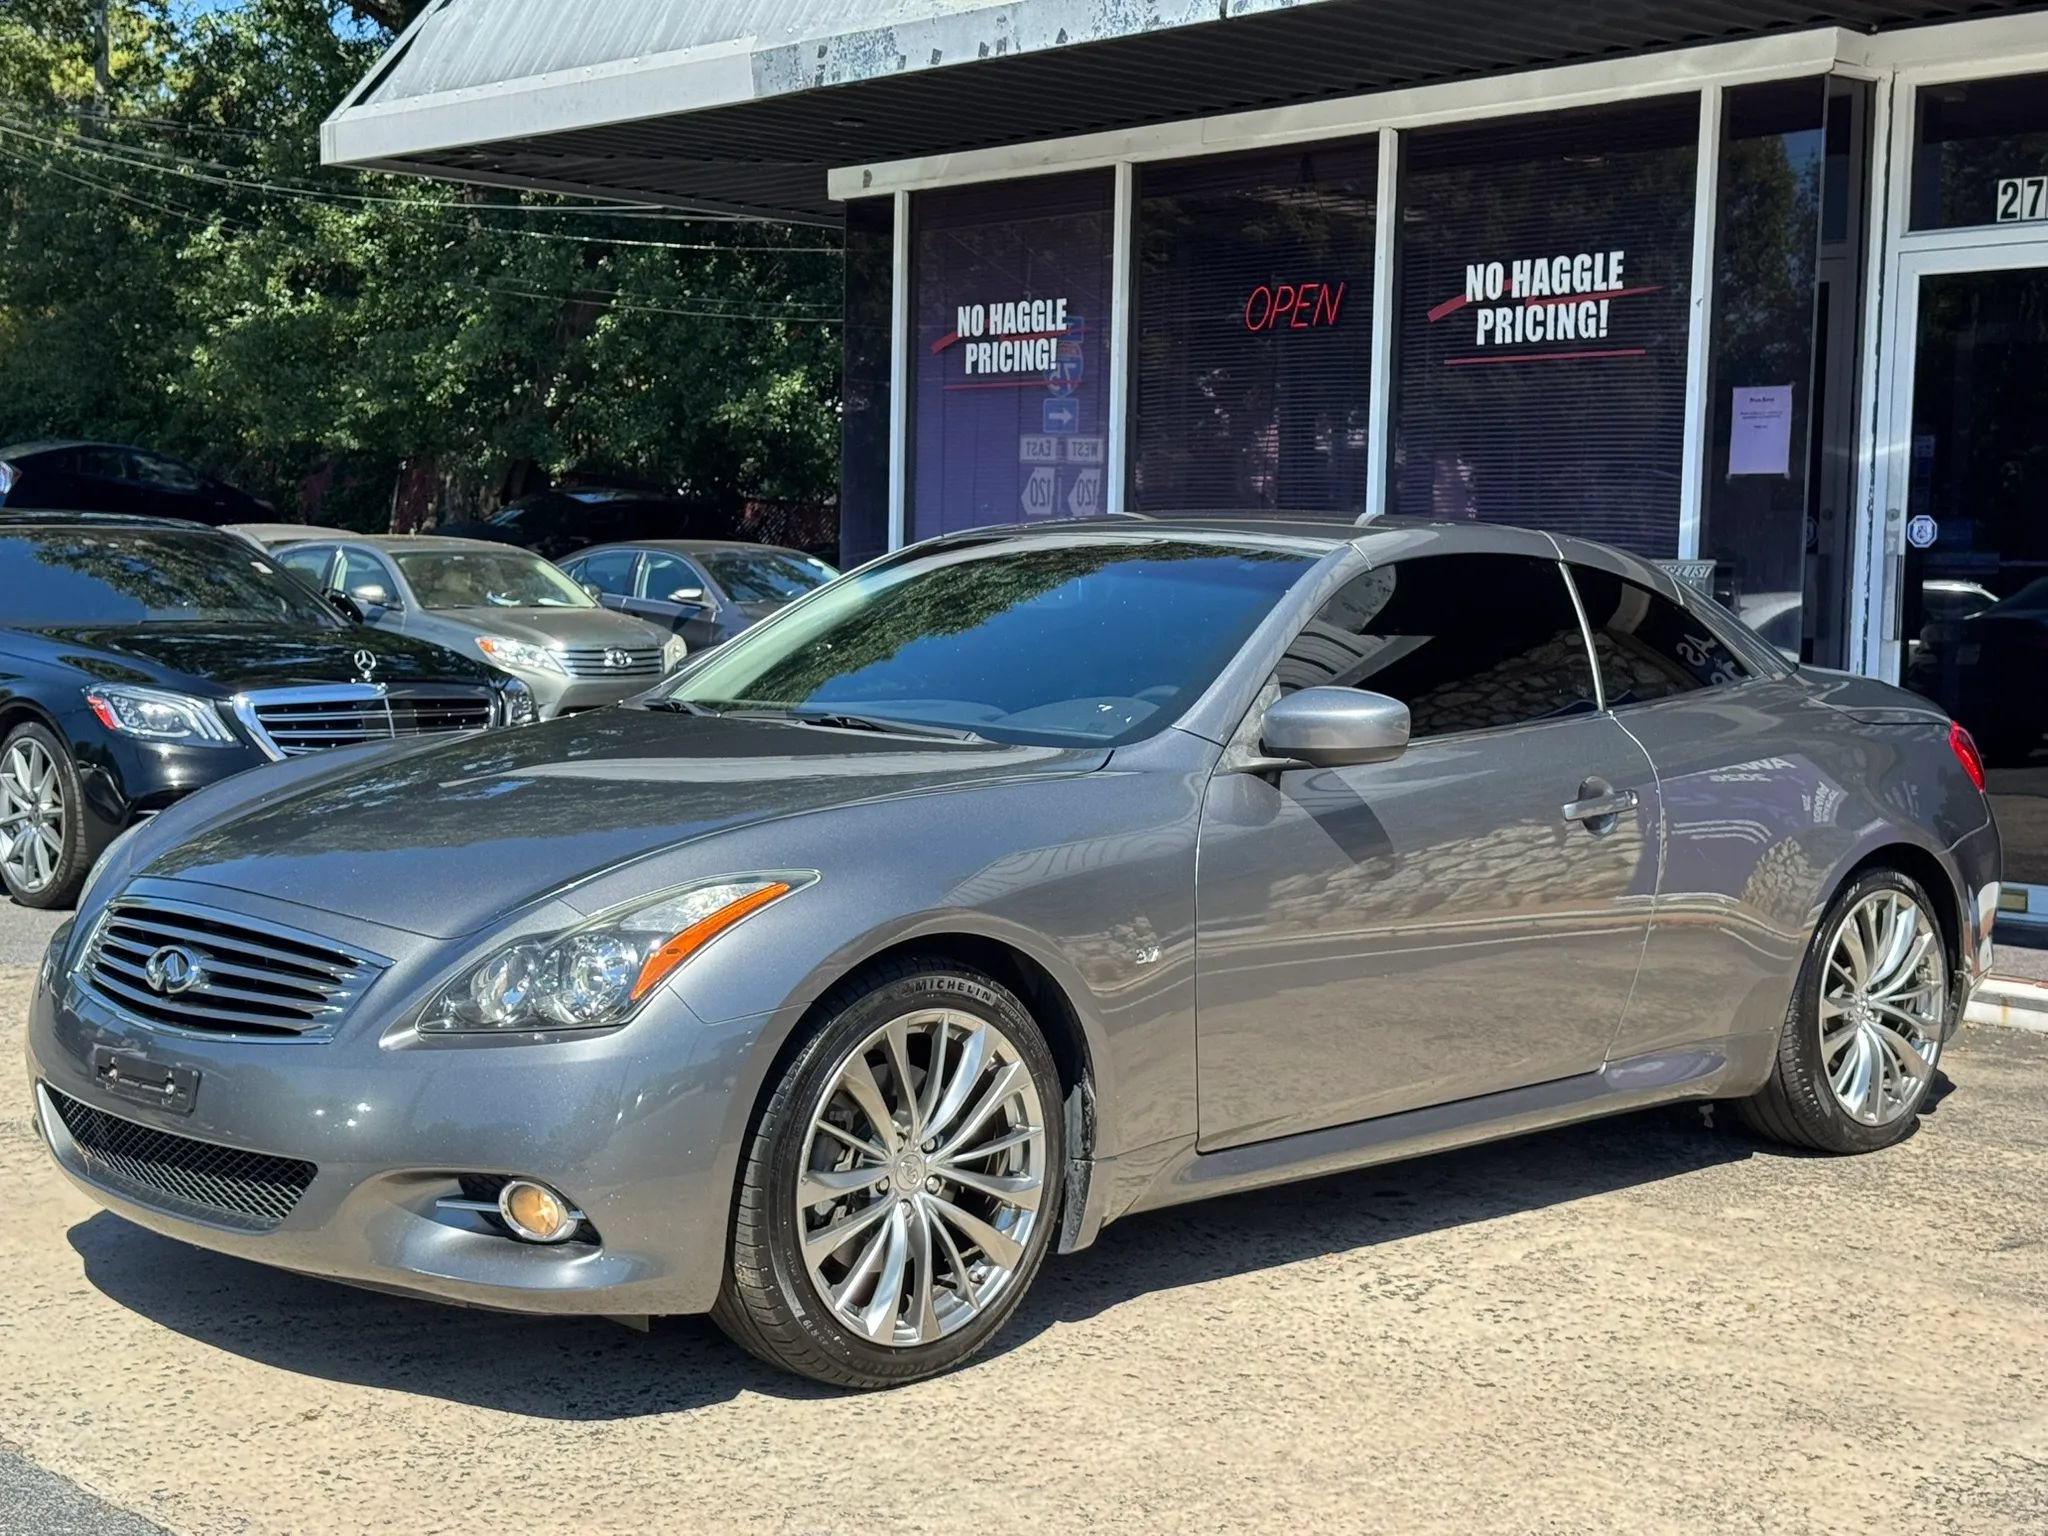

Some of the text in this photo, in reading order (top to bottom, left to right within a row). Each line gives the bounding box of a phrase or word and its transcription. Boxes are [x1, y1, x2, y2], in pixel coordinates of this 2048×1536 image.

[1999, 179, 2045, 220] 27
[1465, 250, 1625, 302] NO HAGGLE
[956, 304, 985, 338] NO
[988, 297, 1068, 335] HAGGLE
[1244, 281, 1345, 331] OPEN
[1475, 299, 1610, 346] PRICING!
[964, 337, 1058, 375] PRICING!
[914, 979, 993, 1002] MICHELIN
